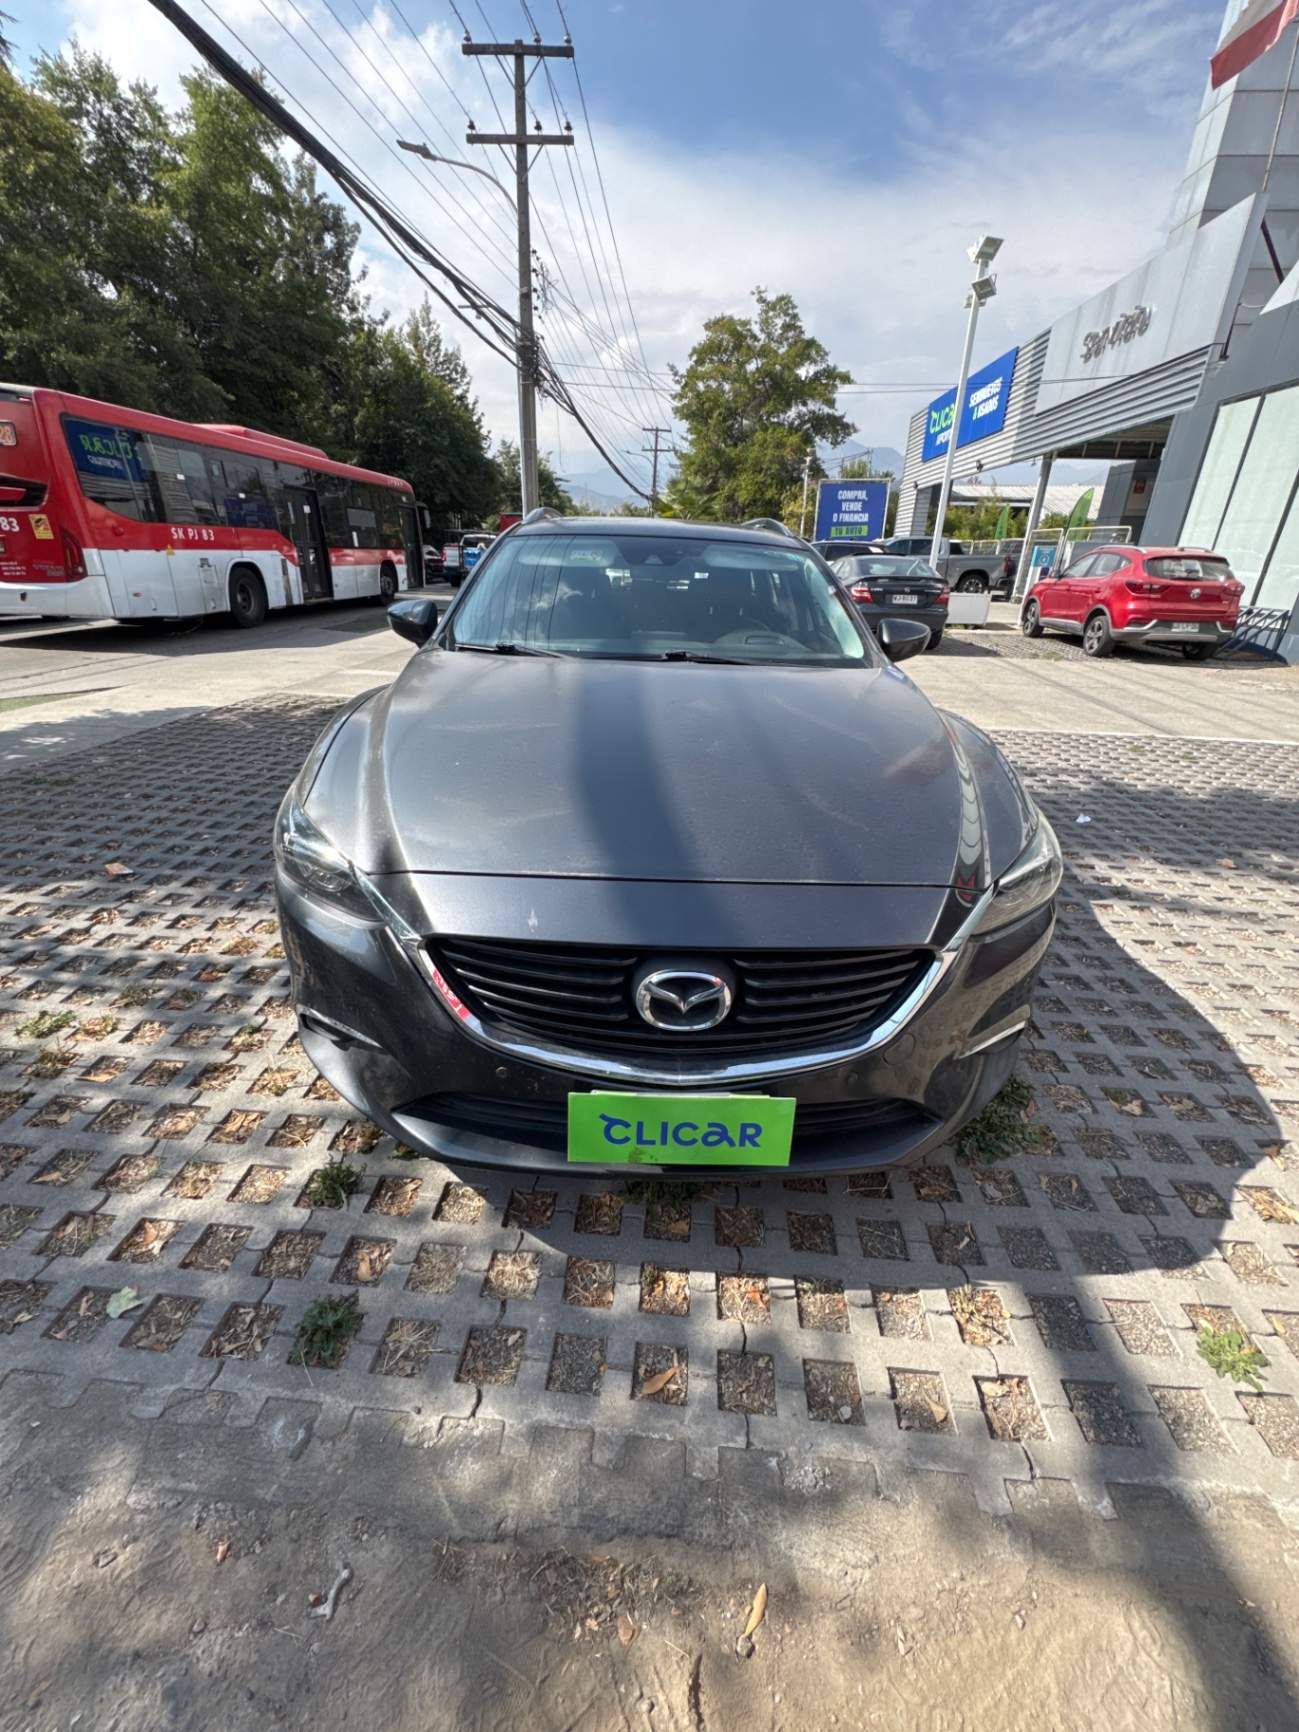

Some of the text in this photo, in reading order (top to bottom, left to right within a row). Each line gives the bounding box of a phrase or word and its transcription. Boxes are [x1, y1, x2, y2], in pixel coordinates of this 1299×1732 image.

[837, 490, 868, 501] COMPRA,
[841, 501, 863, 511] VENDE
[832, 512, 869, 522] O FINANCIA
[170, 527, 185, 540] SK
[201, 528, 215, 541] 83
